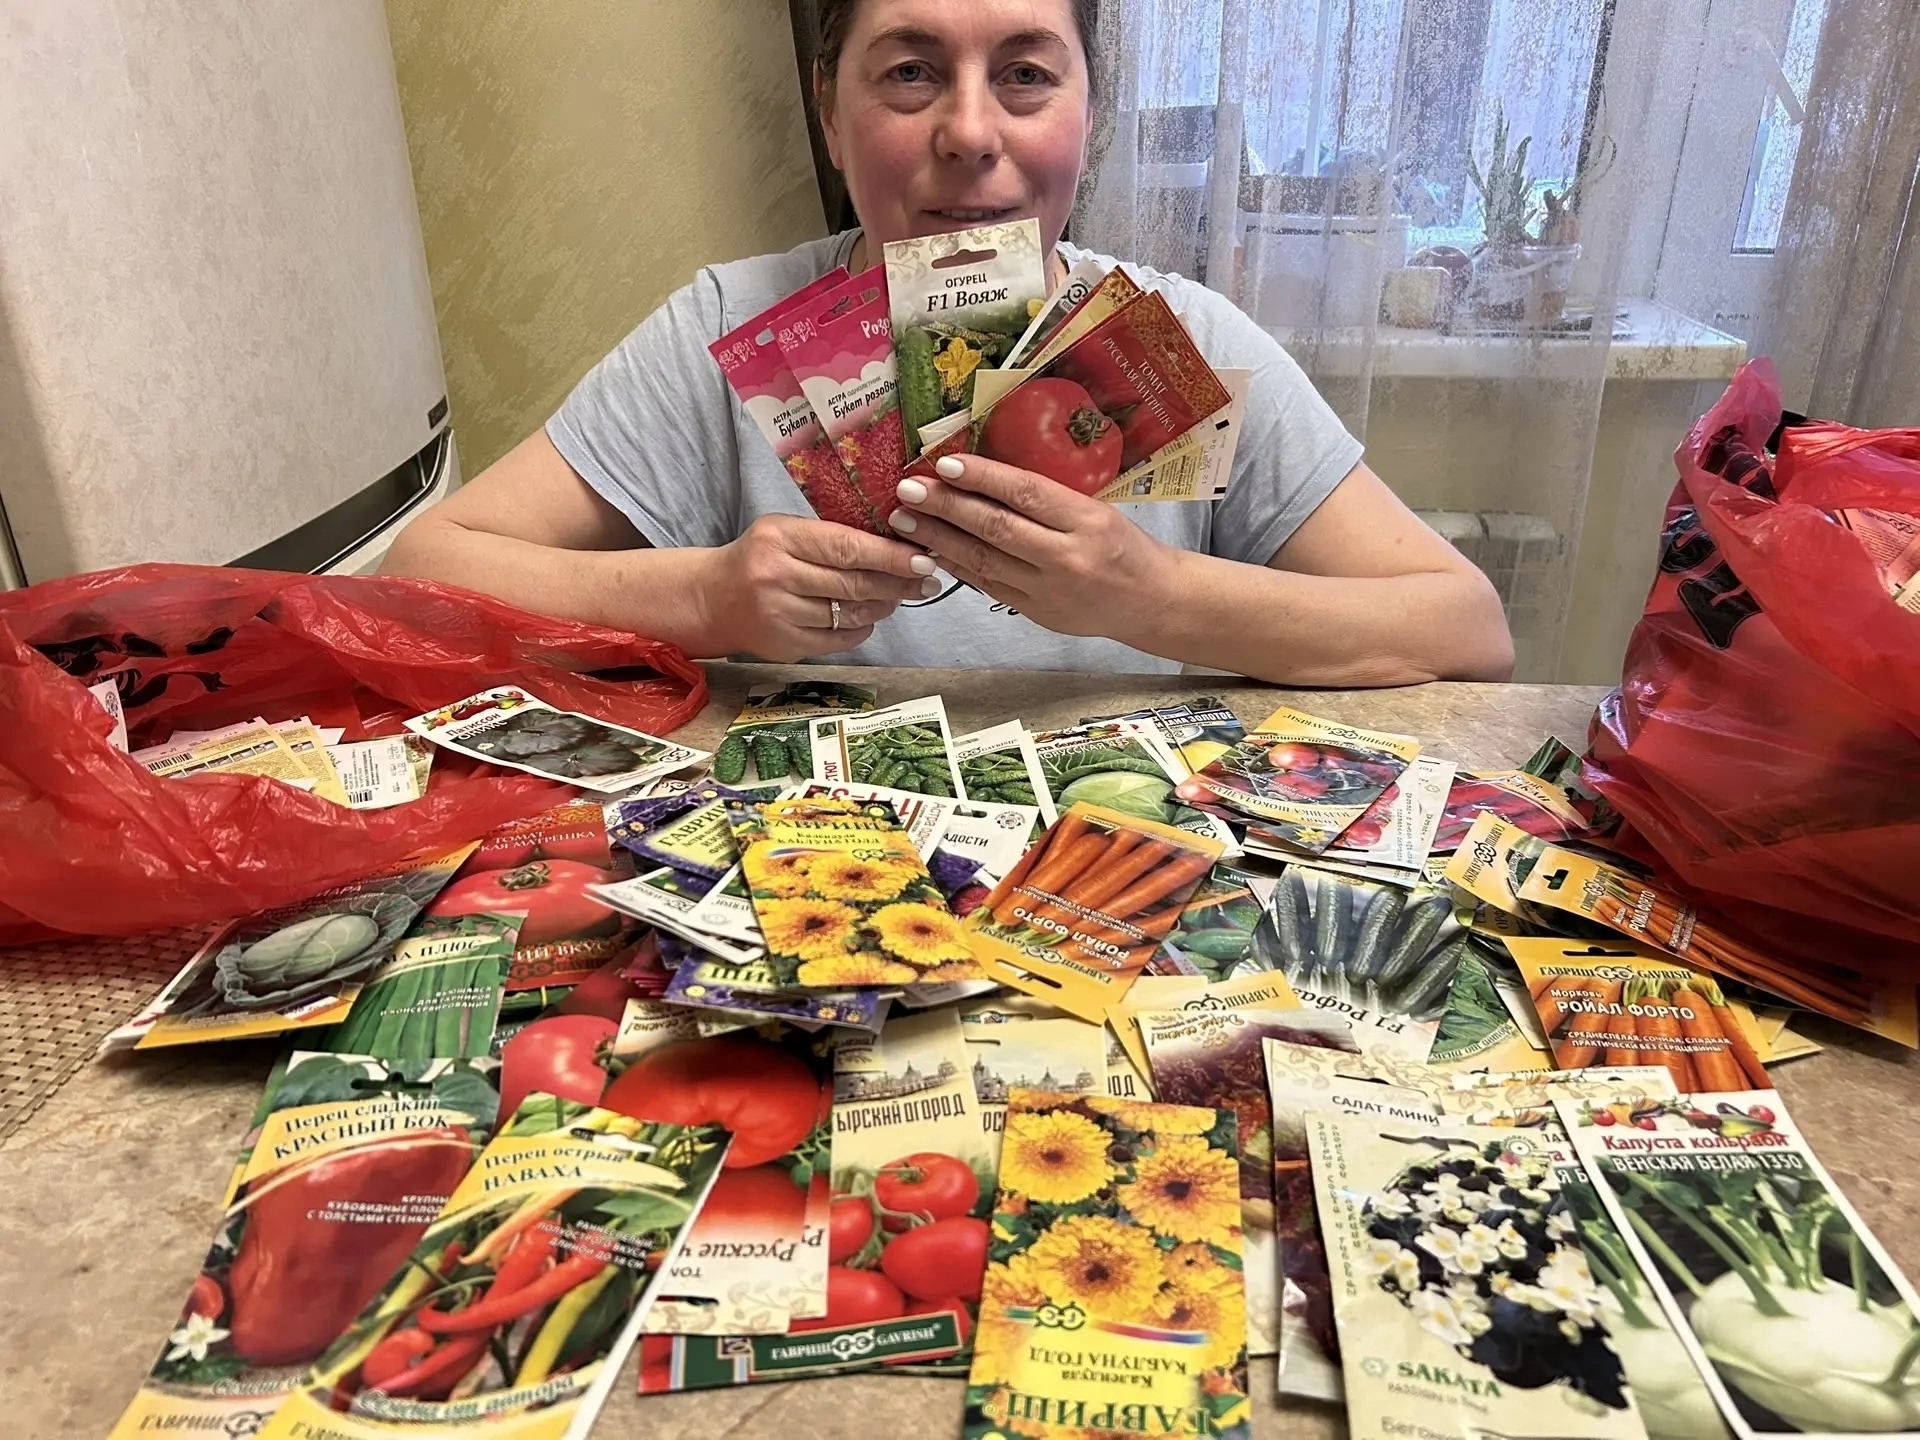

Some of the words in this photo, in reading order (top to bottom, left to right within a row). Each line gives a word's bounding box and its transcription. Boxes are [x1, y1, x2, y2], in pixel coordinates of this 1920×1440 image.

[945, 273, 987, 288] ОГУРЕЦ
[926, 293, 949, 312] F1
[955, 287, 1009, 307] Вояж
[1102, 337, 1140, 381] РУССКАЯ
[1138, 358, 1169, 395] ТОМАТ
[828, 392, 847, 407] АСТРА
[832, 397, 863, 420] Букет
[772, 411, 792, 425] АСТРА
[779, 415, 808, 438] Букет
[445, 713, 501, 737] Патиссон
[1190, 711, 1235, 723] ЗОЛОТОЕ
[493, 831, 546, 845] ТОМАТ
[1013, 906, 1069, 936] ФОРТО
[420, 938, 483, 958] ПЛЮС
[1072, 930, 1131, 960] РОЙАЛ
[1076, 943, 1123, 968] Морковь
[1061, 957, 1112, 985] ГАВРИШ
[1540, 966, 1596, 977] ГАВРИШ
[1637, 969, 1693, 980] GAVRISH
[1224, 986, 1281, 1010] ГАВРИШ
[1550, 989, 1604, 999] Морковь
[1556, 999, 1623, 1016] РОЙАЛ
[1628, 1003, 1696, 1020] ФОРТО
[1376, 1017, 1407, 1035] F1
[1571, 1040, 1638, 1050] ПРАКТИЧЕСКИ
[1639, 1043, 1657, 1051] БЕЗ
[284, 1110, 350, 1134] Перец
[354, 1097, 438, 1117] сладкий
[906, 1093, 966, 1123] ОГОРОД
[1332, 1095, 1384, 1113] САЛАТ
[1389, 1107, 1441, 1126] МИНИ
[274, 1113, 395, 1159] КРАСНЫЙ
[403, 1114, 452, 1130] БОК
[1603, 1134, 1683, 1152] Капуста
[1691, 1134, 1790, 1150] кольраби
[484, 1147, 547, 1169] Перец
[553, 1147, 626, 1163] острый
[1614, 1155, 1695, 1173] ВЕНСКАЯ
[1700, 1155, 1752, 1170] БЕЛАЯ
[1761, 1154, 1803, 1170] 1350
[484, 1165, 583, 1191] НАВАХА
[318, 1211, 384, 1223] ТОЛСТЫМИ
[327, 1201, 407, 1213] КУБОВИДНЫЕ
[612, 1242, 648, 1259] ВКУСА
[700, 1241, 798, 1262] Русские
[876, 1328, 936, 1347] GAVRISH
[771, 1342, 833, 1361] ГАВРИШ
[1029, 1345, 1083, 1366] ГОЛД
[1088, 1352, 1188, 1376] КАБЛУНА
[1061, 1370, 1154, 1388] Календула
[1397, 1361, 1502, 1398] SAKATA
[139, 1411, 225, 1431] ГАВРИШ
[1006, 1390, 1212, 1435] ГАВРИШ
